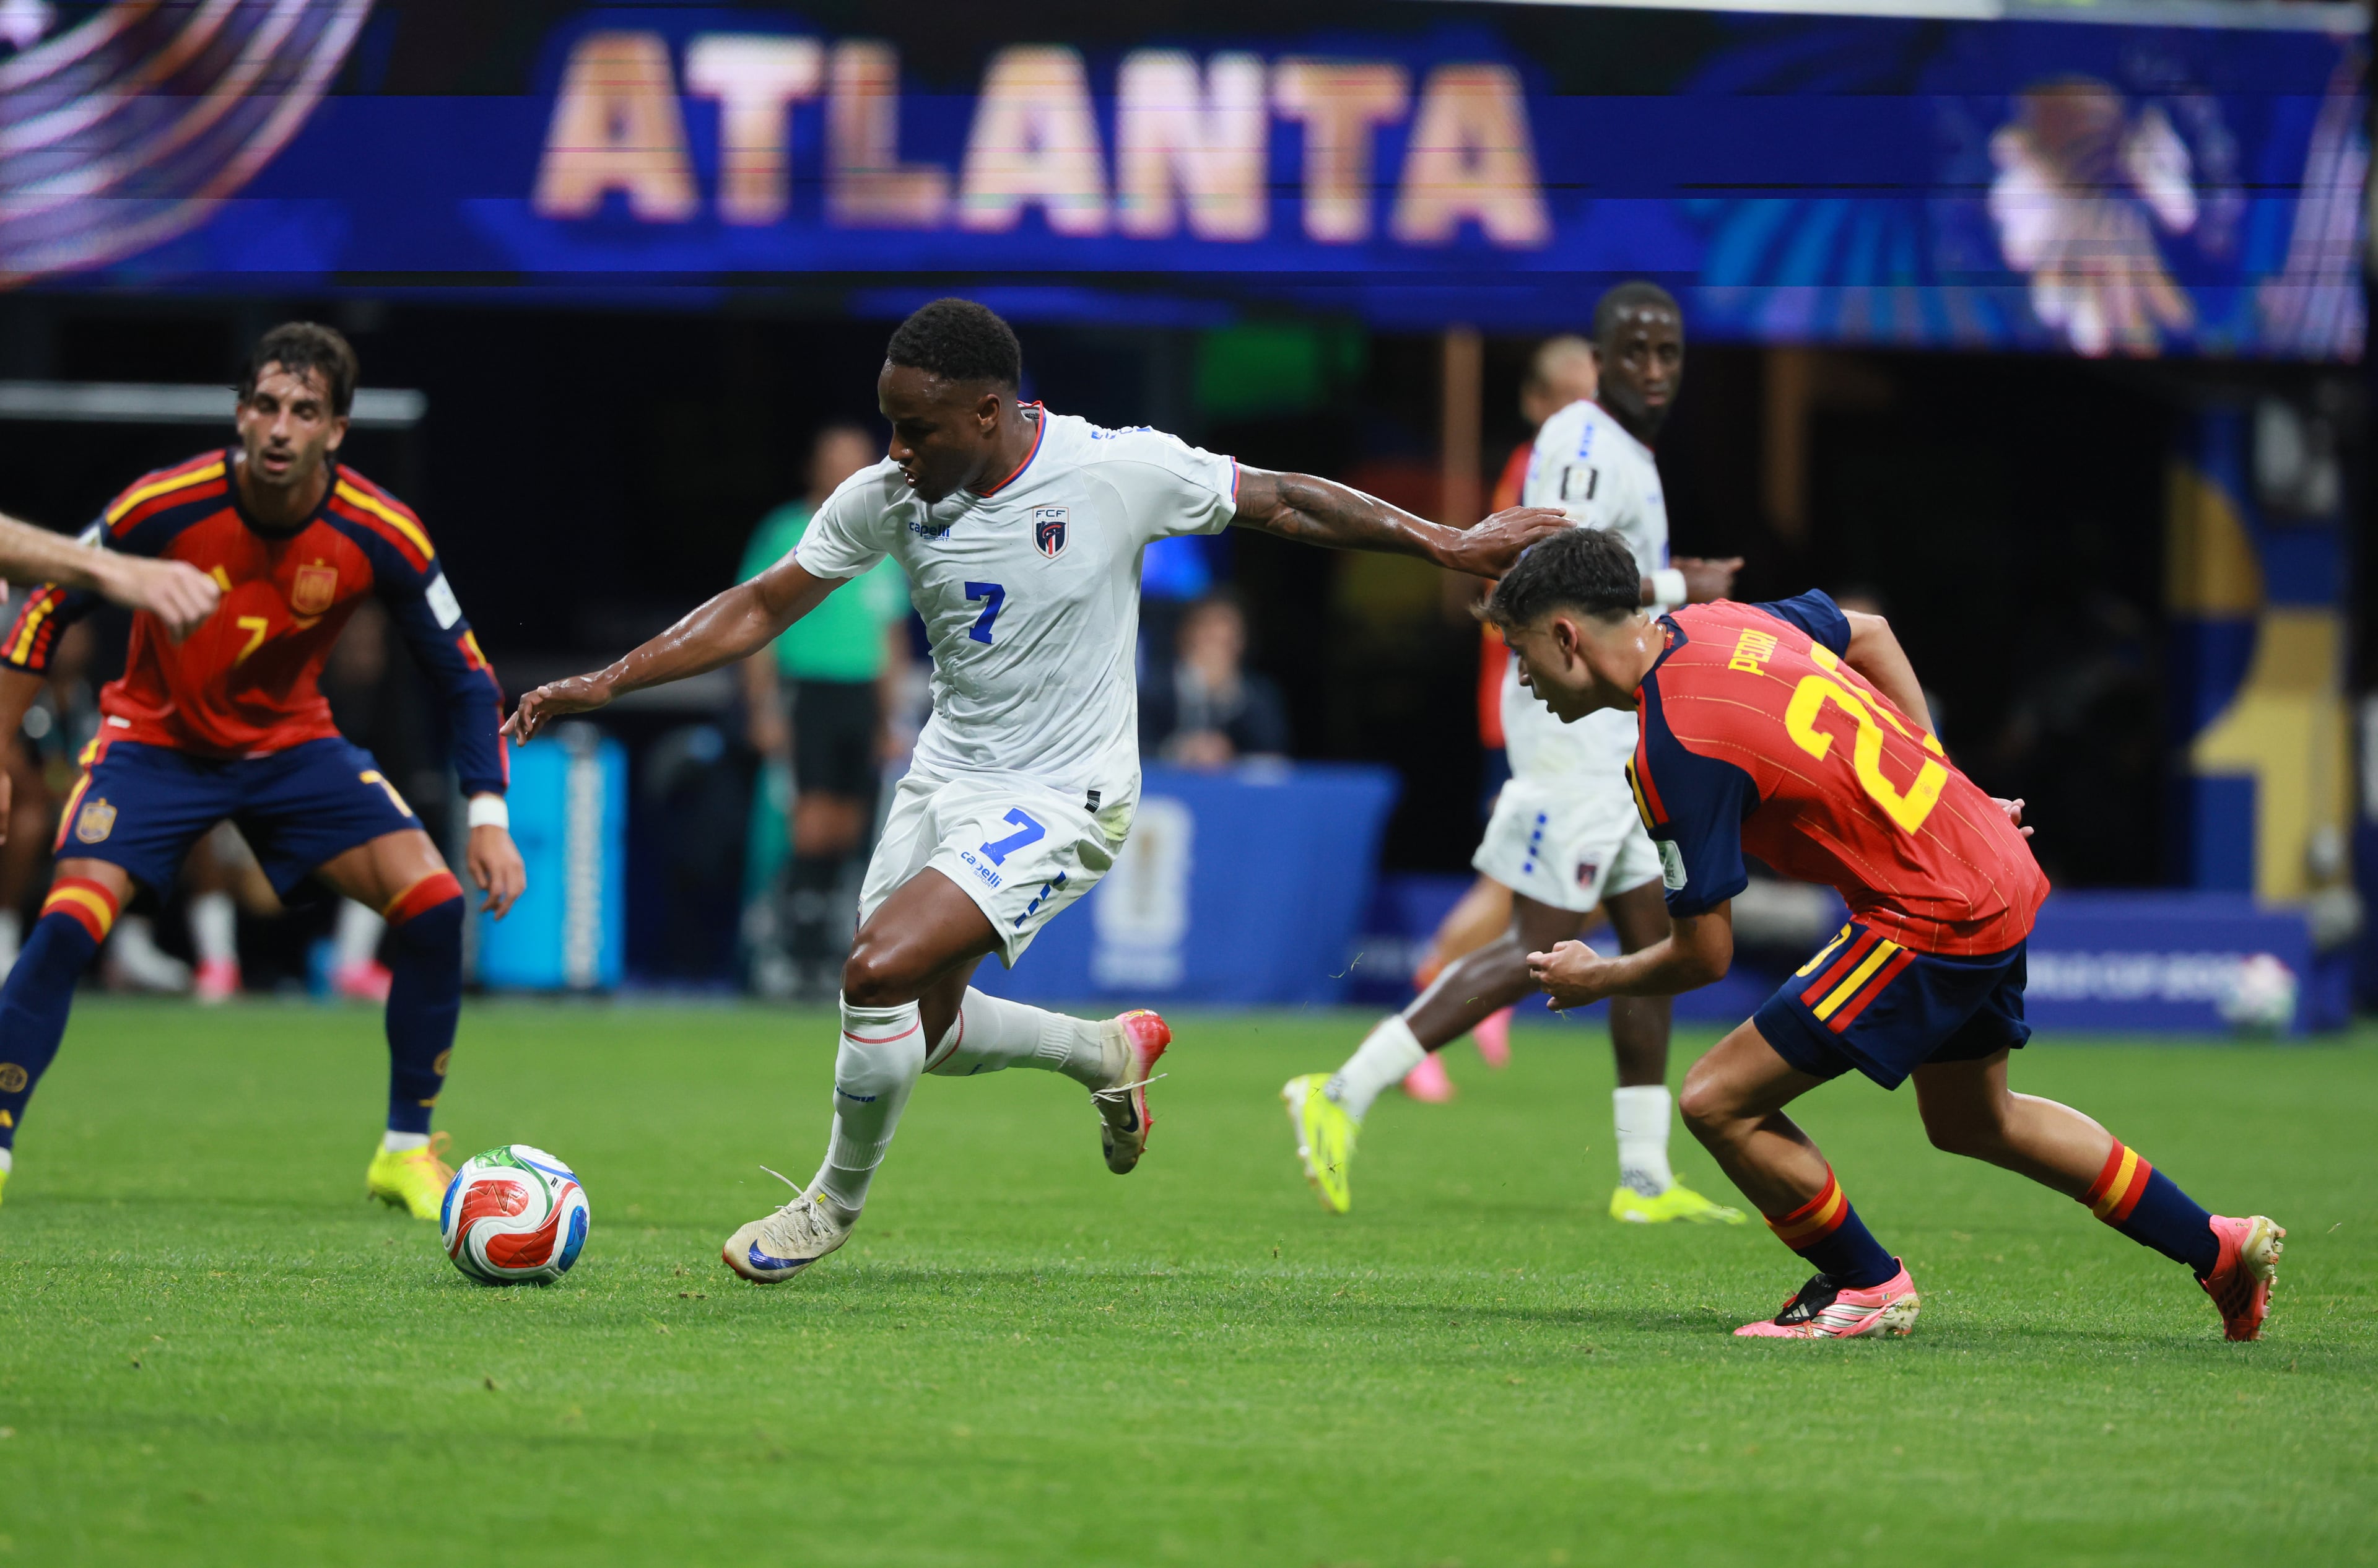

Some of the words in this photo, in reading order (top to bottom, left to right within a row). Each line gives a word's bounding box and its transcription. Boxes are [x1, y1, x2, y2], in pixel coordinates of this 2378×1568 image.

[533, 28, 1553, 245] ATLANTA
[908, 521, 951, 538] capelli
[1035, 510, 1066, 518] FCF
[964, 581, 1006, 645] 7
[237, 614, 269, 667] 7
[1727, 627, 1778, 676] PEDRI
[978, 807, 1046, 867] 7
[960, 851, 1003, 888] capelli
